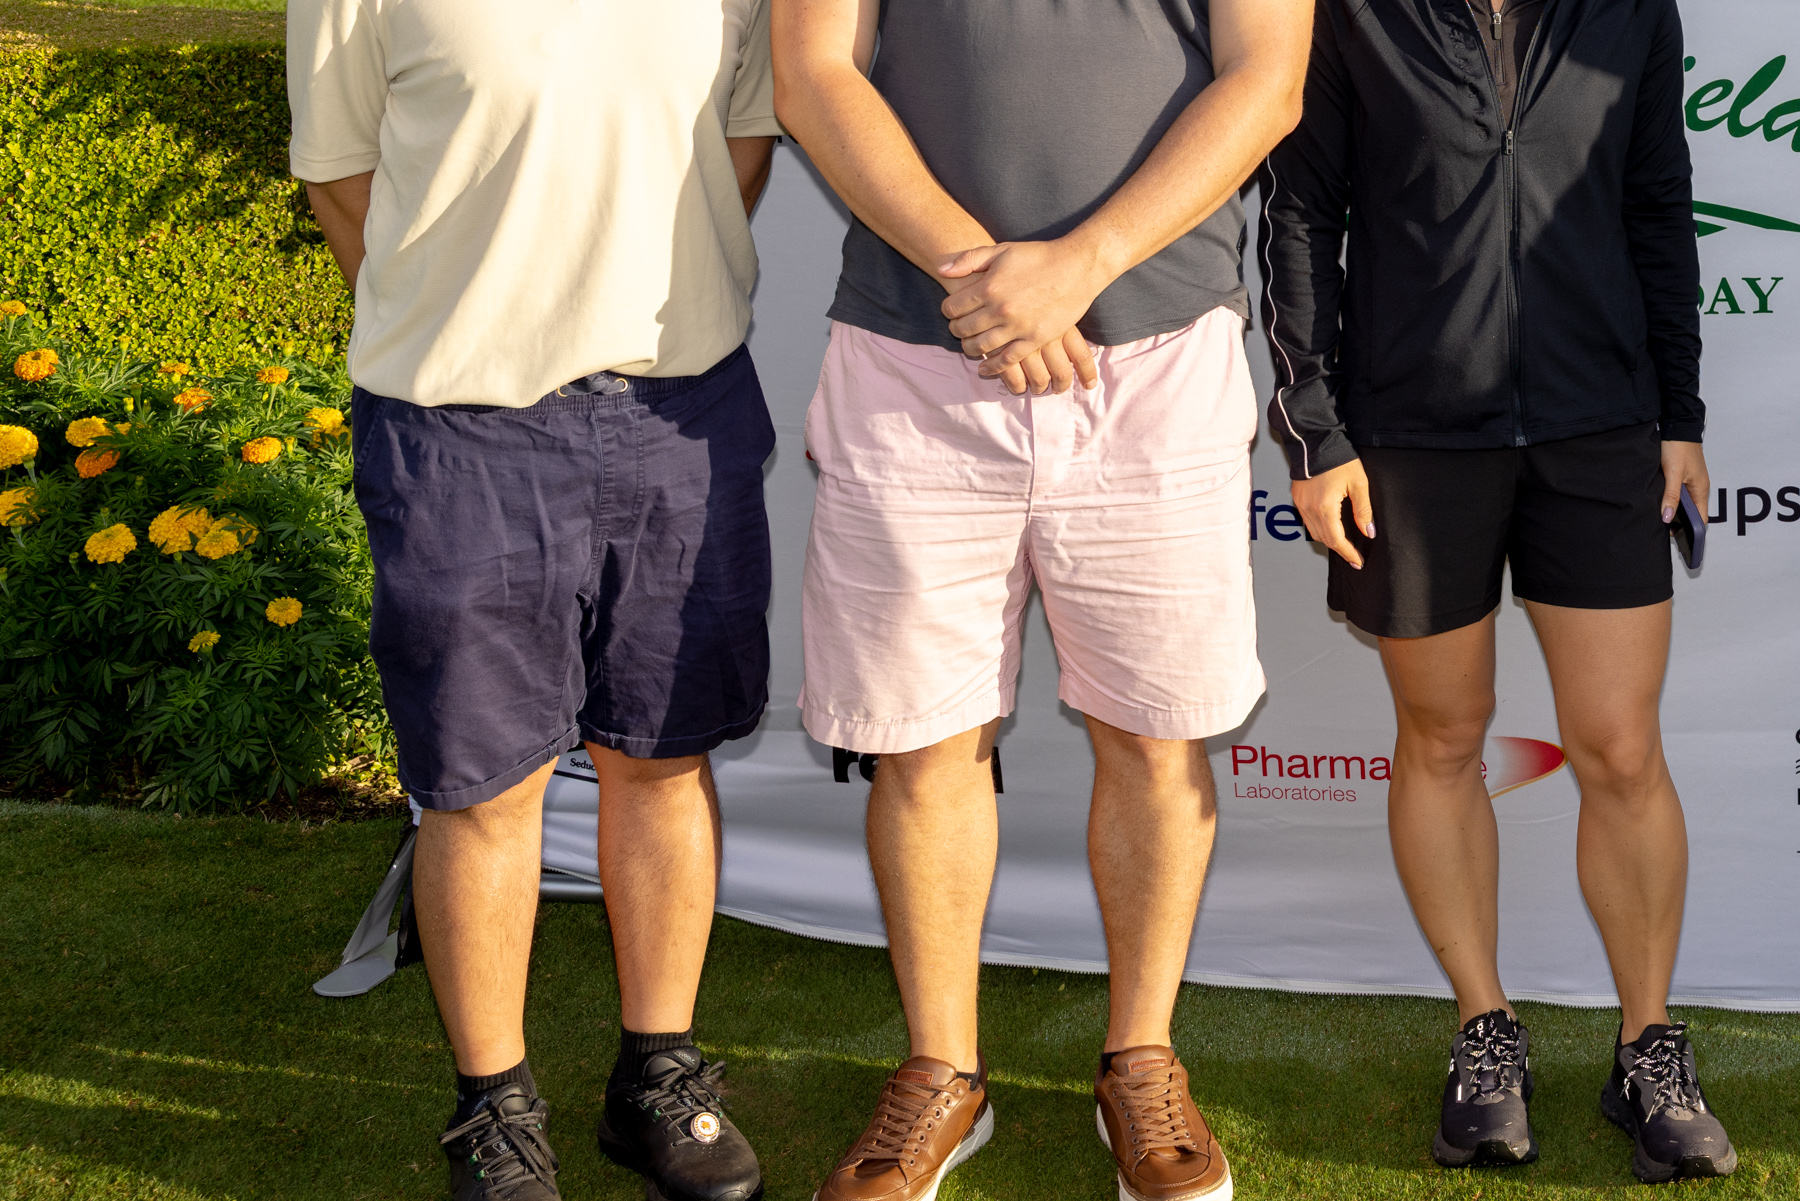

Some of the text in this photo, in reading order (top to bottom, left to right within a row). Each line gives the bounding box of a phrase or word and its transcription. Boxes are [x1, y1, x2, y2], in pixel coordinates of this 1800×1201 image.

[1699, 276, 1784, 315] AY
[569, 757, 597, 771] Seduc
[1231, 744, 1487, 781] Pharma
[1233, 782, 1357, 803] Laboratories
